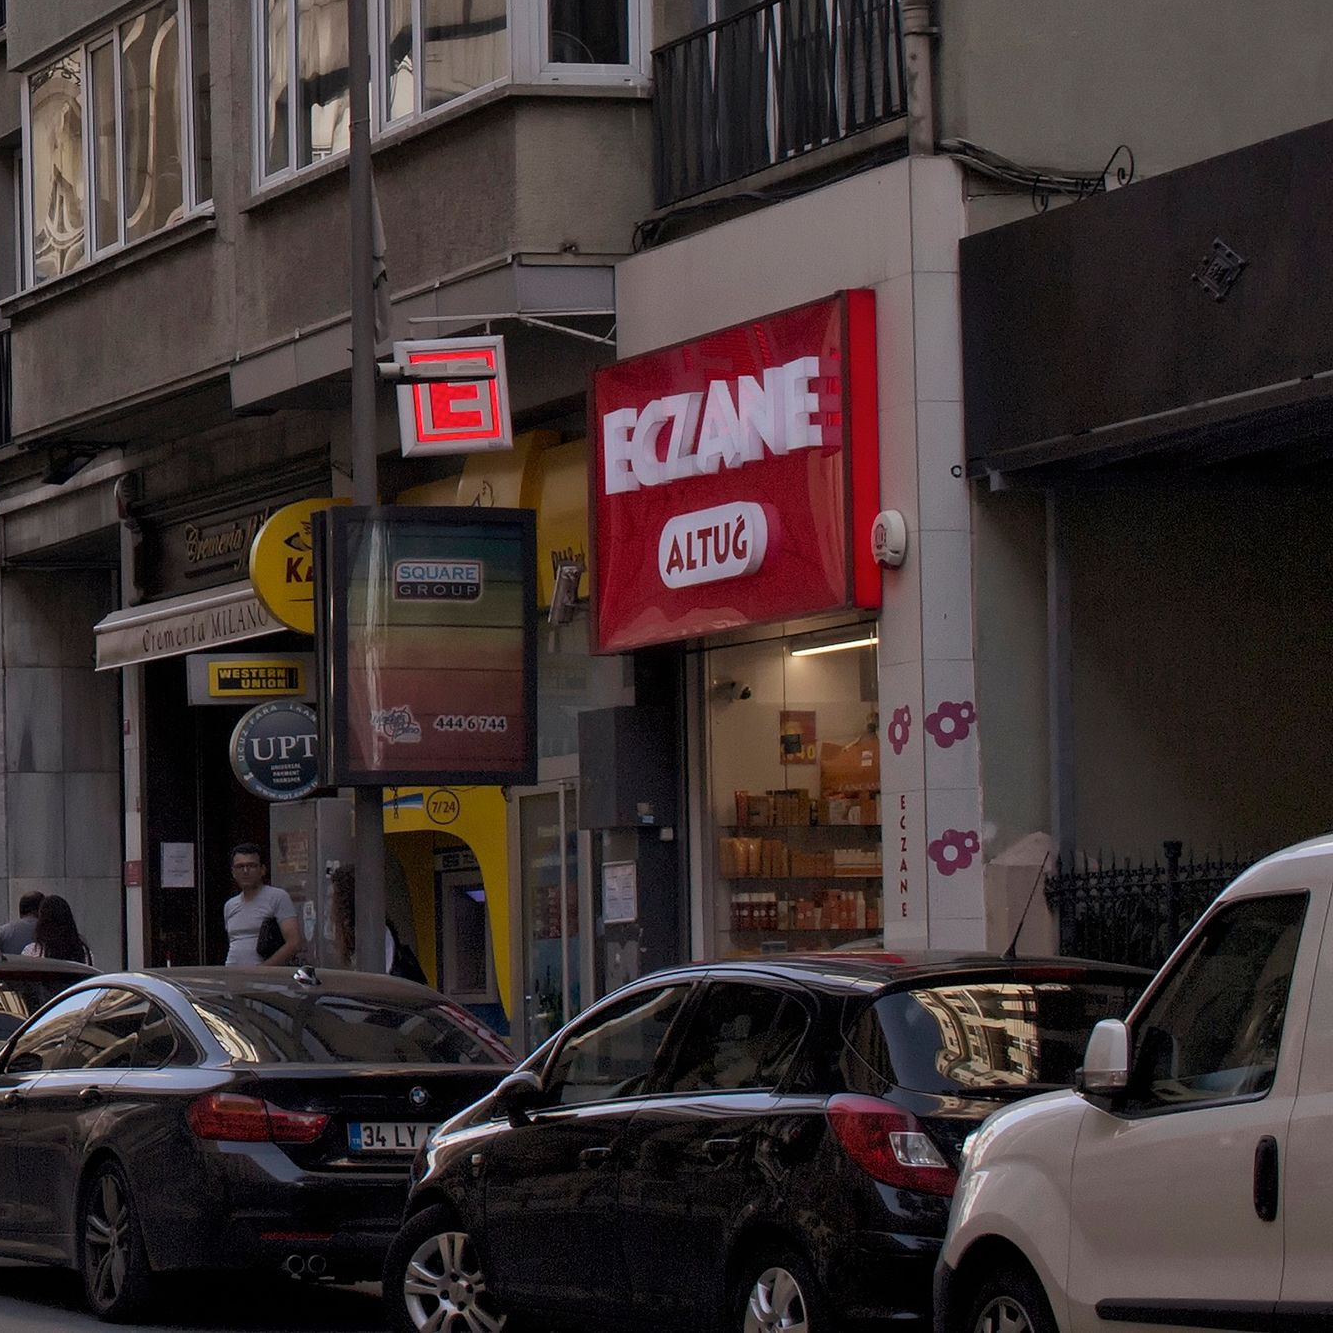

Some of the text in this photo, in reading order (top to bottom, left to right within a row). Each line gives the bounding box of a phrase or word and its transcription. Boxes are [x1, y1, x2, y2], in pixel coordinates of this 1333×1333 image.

[603, 356, 824, 496] ECZANE
[399, 566, 477, 580] SQUARE
[398, 584, 477, 596] GROUP
[141, 617, 206, 653] Cremeria
[218, 668, 287, 679] WESTERN
[240, 678, 287, 689] UNION
[436, 717, 506, 731] 444 6 744
[250, 734, 319, 761] UPT
[431, 801, 456, 813] 7/24
[899, 794, 909, 918] ECZANE
[363, 1125, 386, 1147] 34
[394, 1125, 417, 1147] LY
